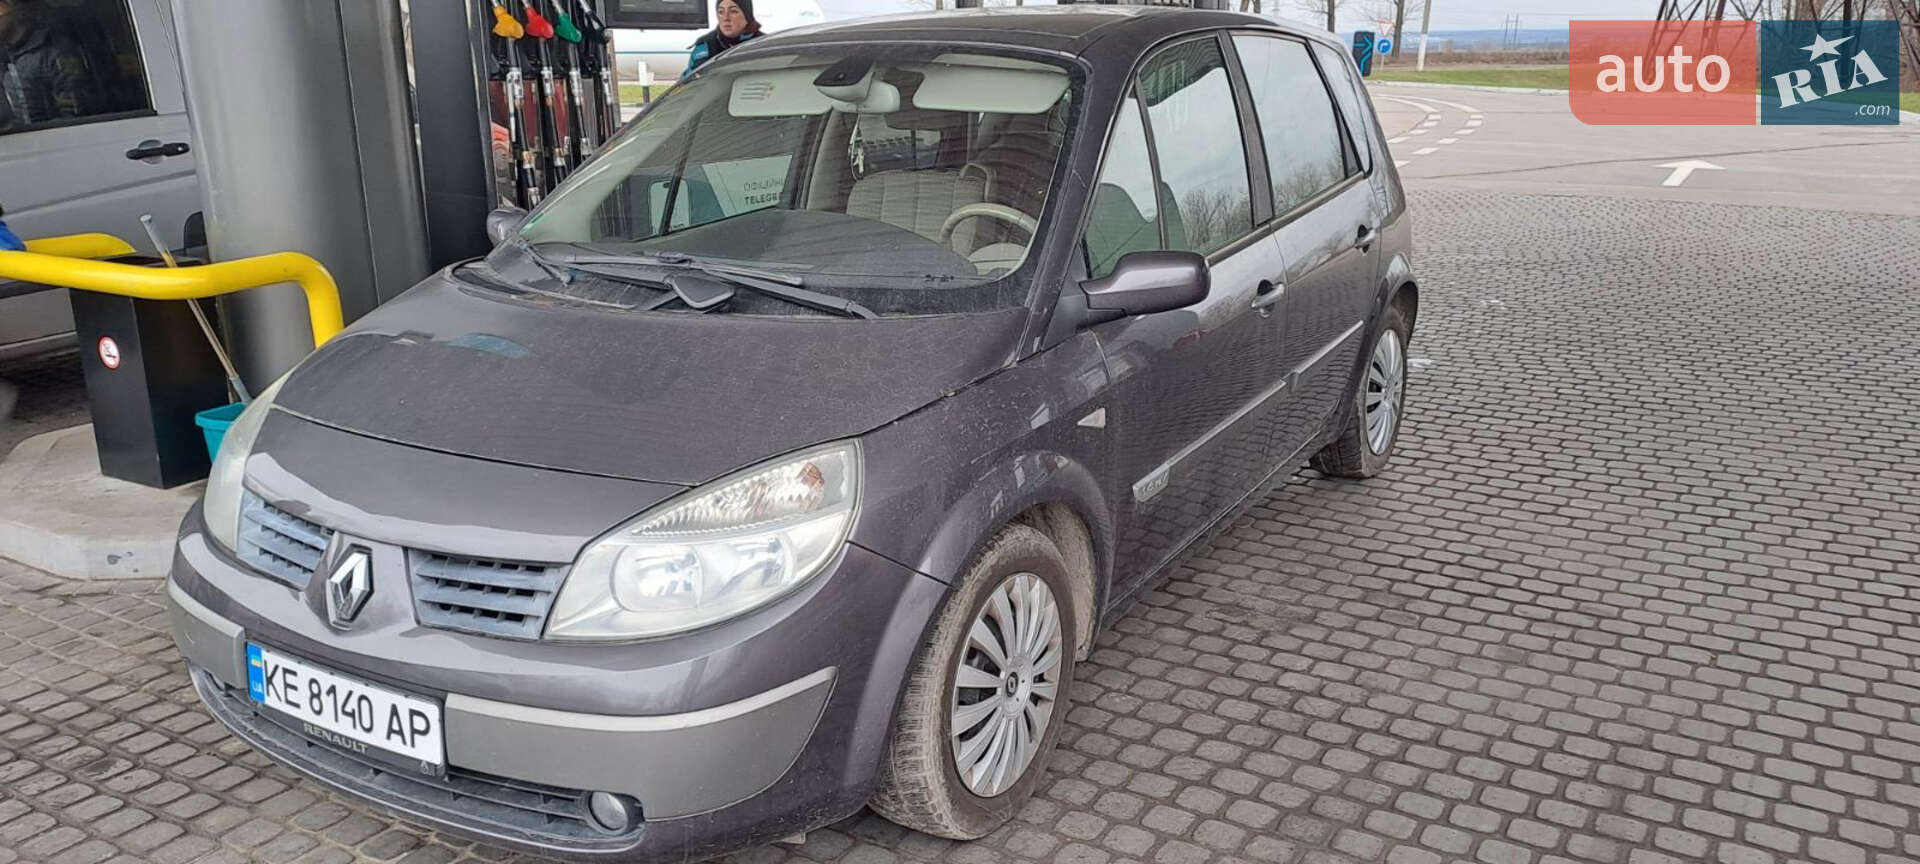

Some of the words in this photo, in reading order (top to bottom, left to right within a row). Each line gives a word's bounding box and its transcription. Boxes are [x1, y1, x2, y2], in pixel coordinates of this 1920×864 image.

[251, 680, 264, 694] UA
[263, 659, 301, 710] KE
[308, 678, 374, 734] 8140
[386, 703, 430, 748] AP
[303, 722, 368, 754] RENAULT
